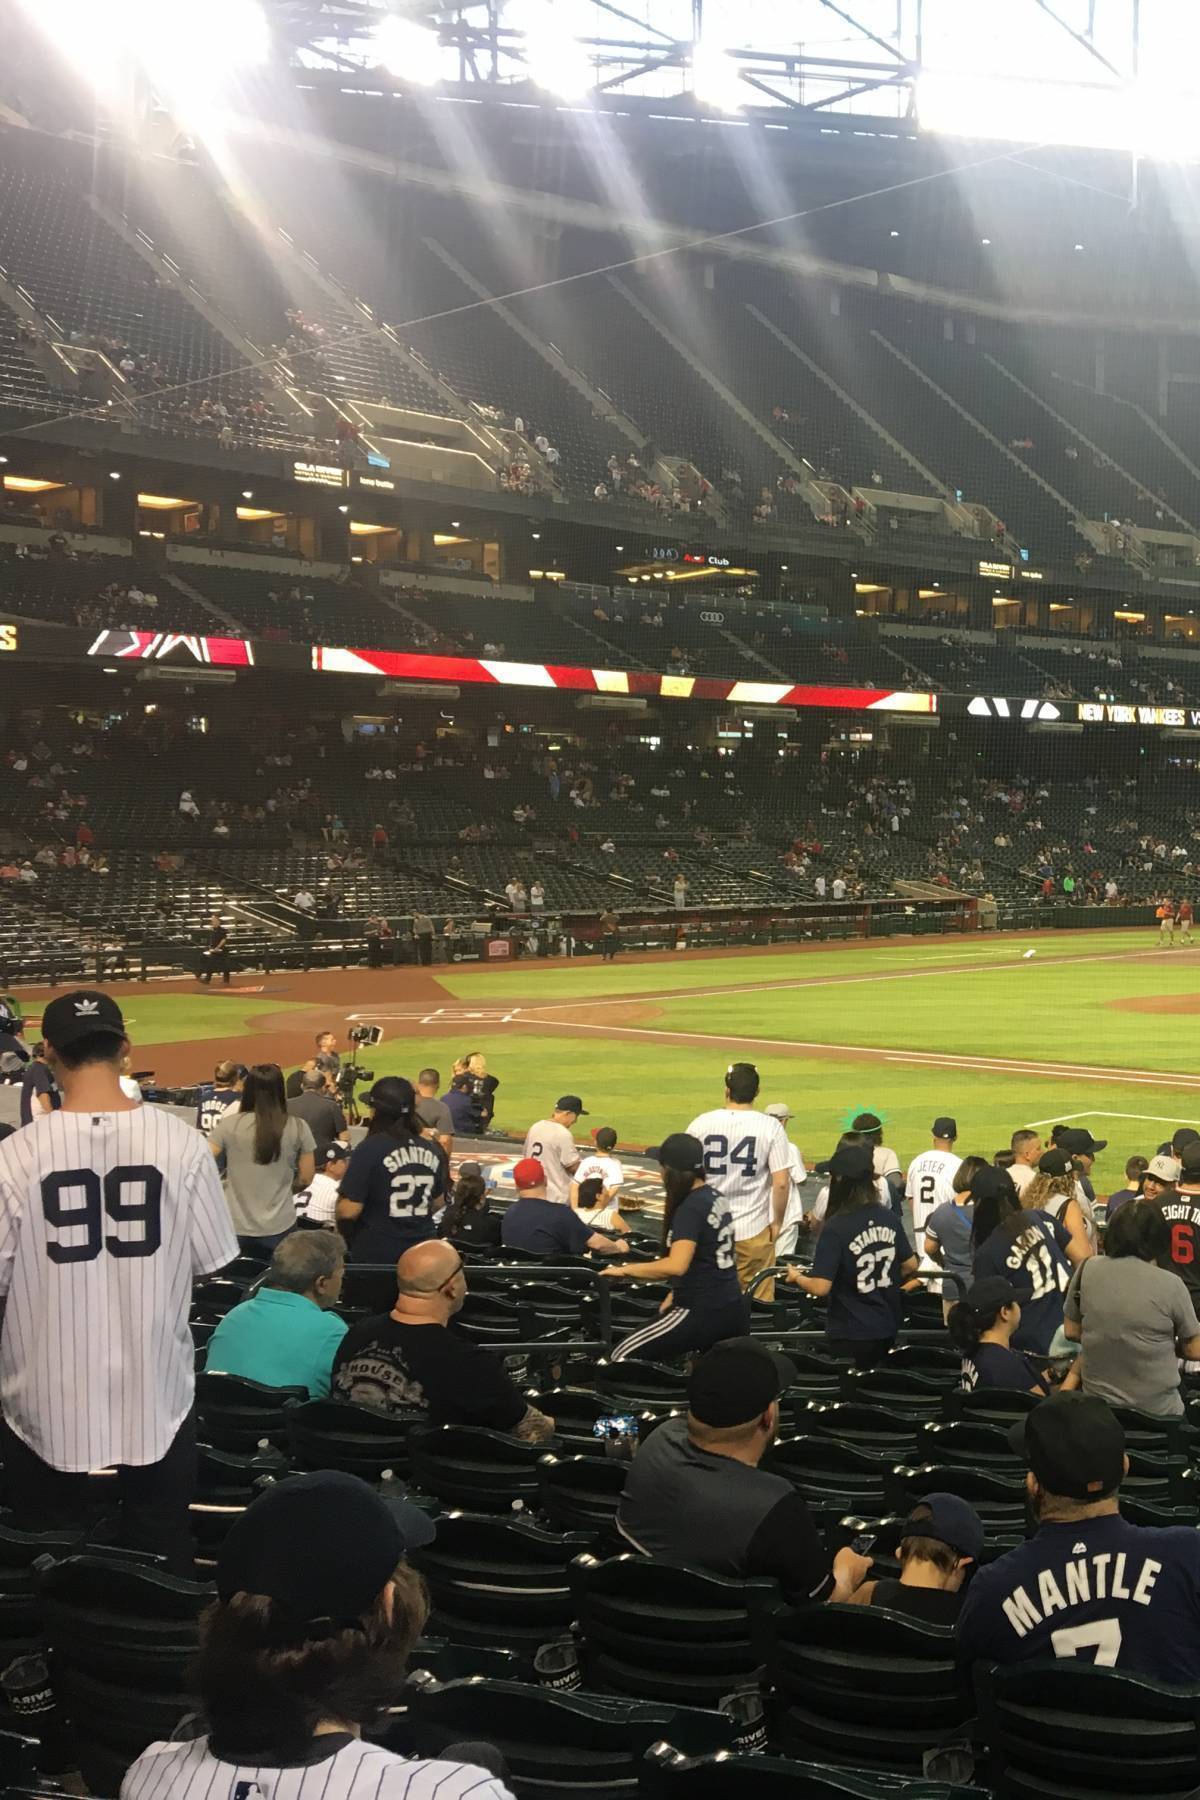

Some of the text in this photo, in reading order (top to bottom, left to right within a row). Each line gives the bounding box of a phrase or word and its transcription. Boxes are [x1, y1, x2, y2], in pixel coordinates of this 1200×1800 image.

[708, 556, 729, 565] Club
[1078, 703, 1104, 722] NEW
[1107, 705, 1136, 723] YORK
[1139, 707, 1185, 725] YANKEES
[383, 1146, 440, 1173] STANTON
[532, 1142, 543, 1158] 2
[704, 1134, 757, 1177] 24
[917, 1160, 945, 1175] JETER
[389, 1174, 435, 1217] 27
[920, 1175, 936, 1204] 2
[40, 1165, 163, 1264] 99
[849, 1226, 896, 1255] STANTON
[1171, 1224, 1194, 1264] 6
[857, 1247, 896, 1293] 27
[1002, 1552, 1162, 1638] MANTLE
[1051, 1617, 1122, 1667] 7
